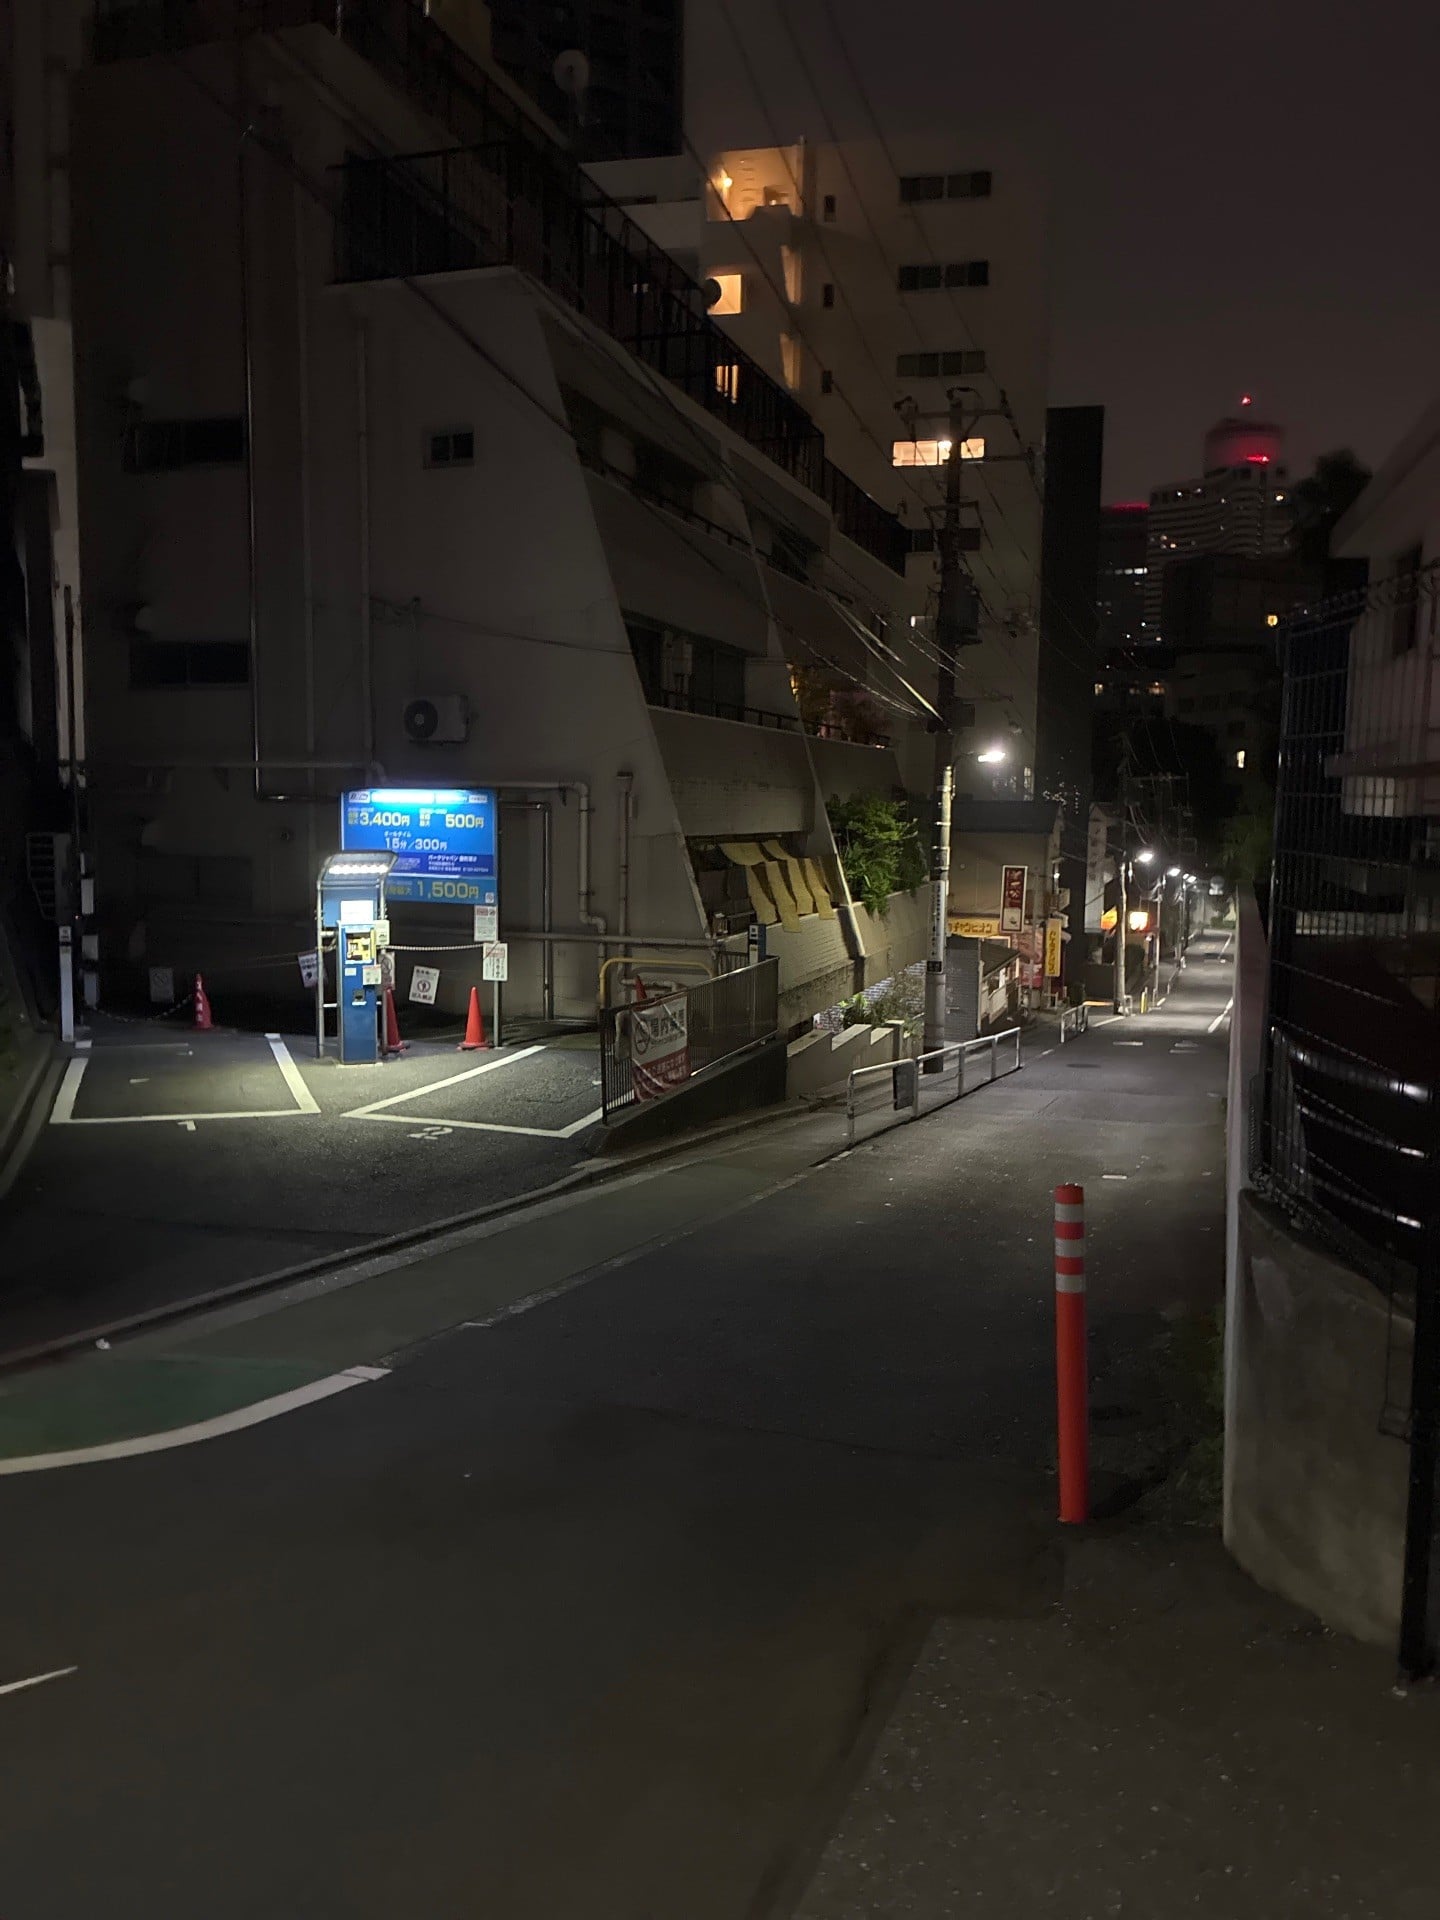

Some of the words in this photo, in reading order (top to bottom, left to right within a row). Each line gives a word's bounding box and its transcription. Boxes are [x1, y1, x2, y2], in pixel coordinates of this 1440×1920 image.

[359, 811, 411, 827] 3,400円
[445, 813, 484, 829] 500円
[417, 881, 479, 899] 1,500円
